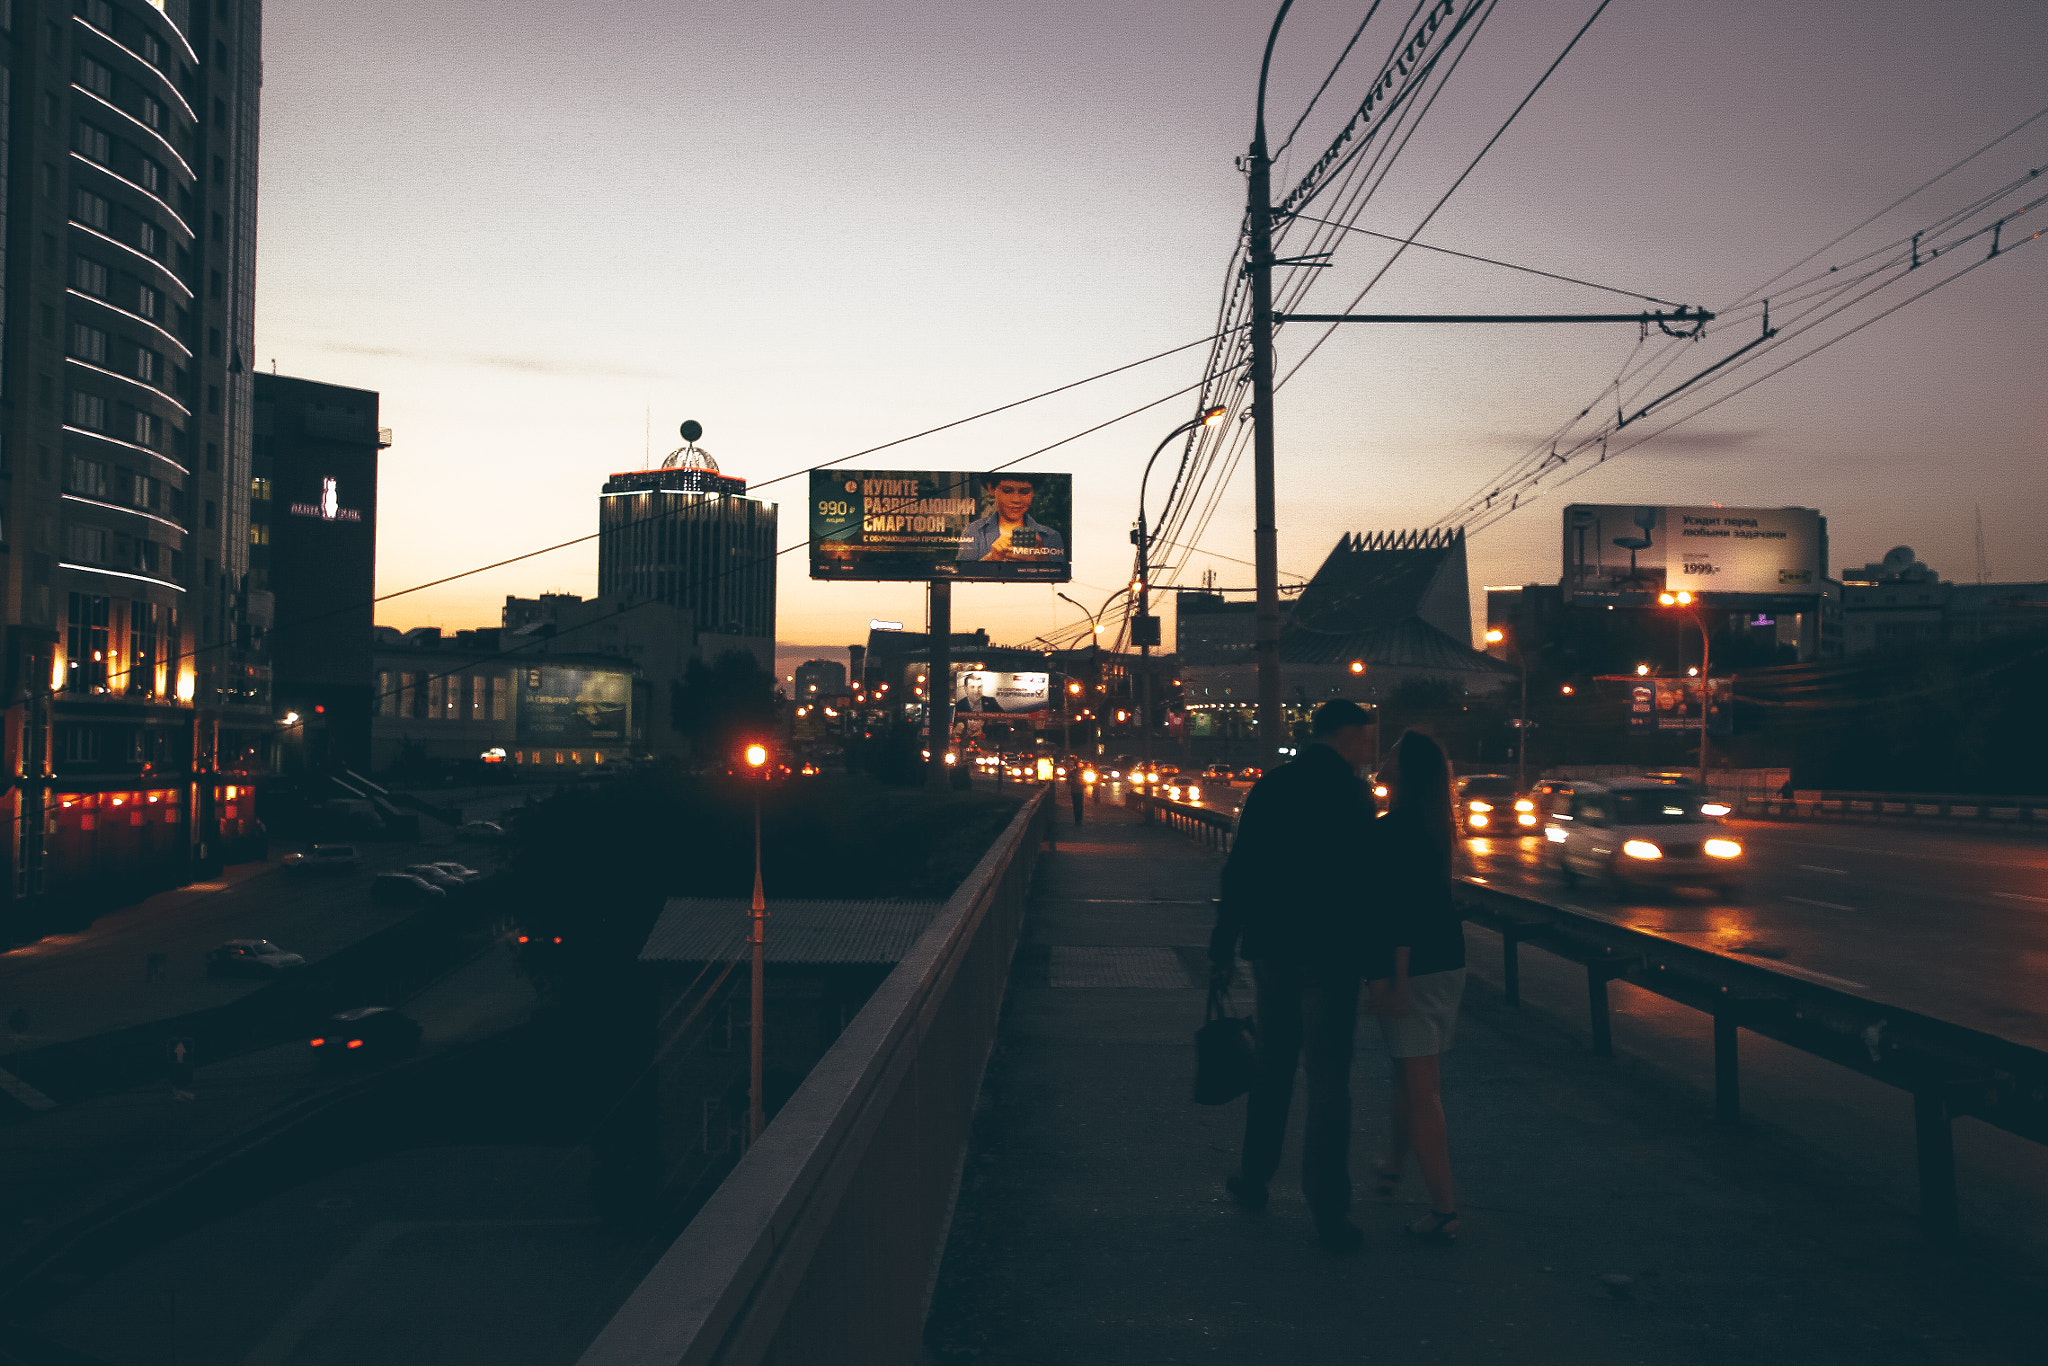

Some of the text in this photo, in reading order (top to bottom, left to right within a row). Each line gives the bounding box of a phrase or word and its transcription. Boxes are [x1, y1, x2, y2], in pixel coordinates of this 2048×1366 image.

[863, 479, 918, 496] КУПИТЕ
[818, 501, 847, 516] 990
[863, 514, 946, 533] СМАРТФОН
